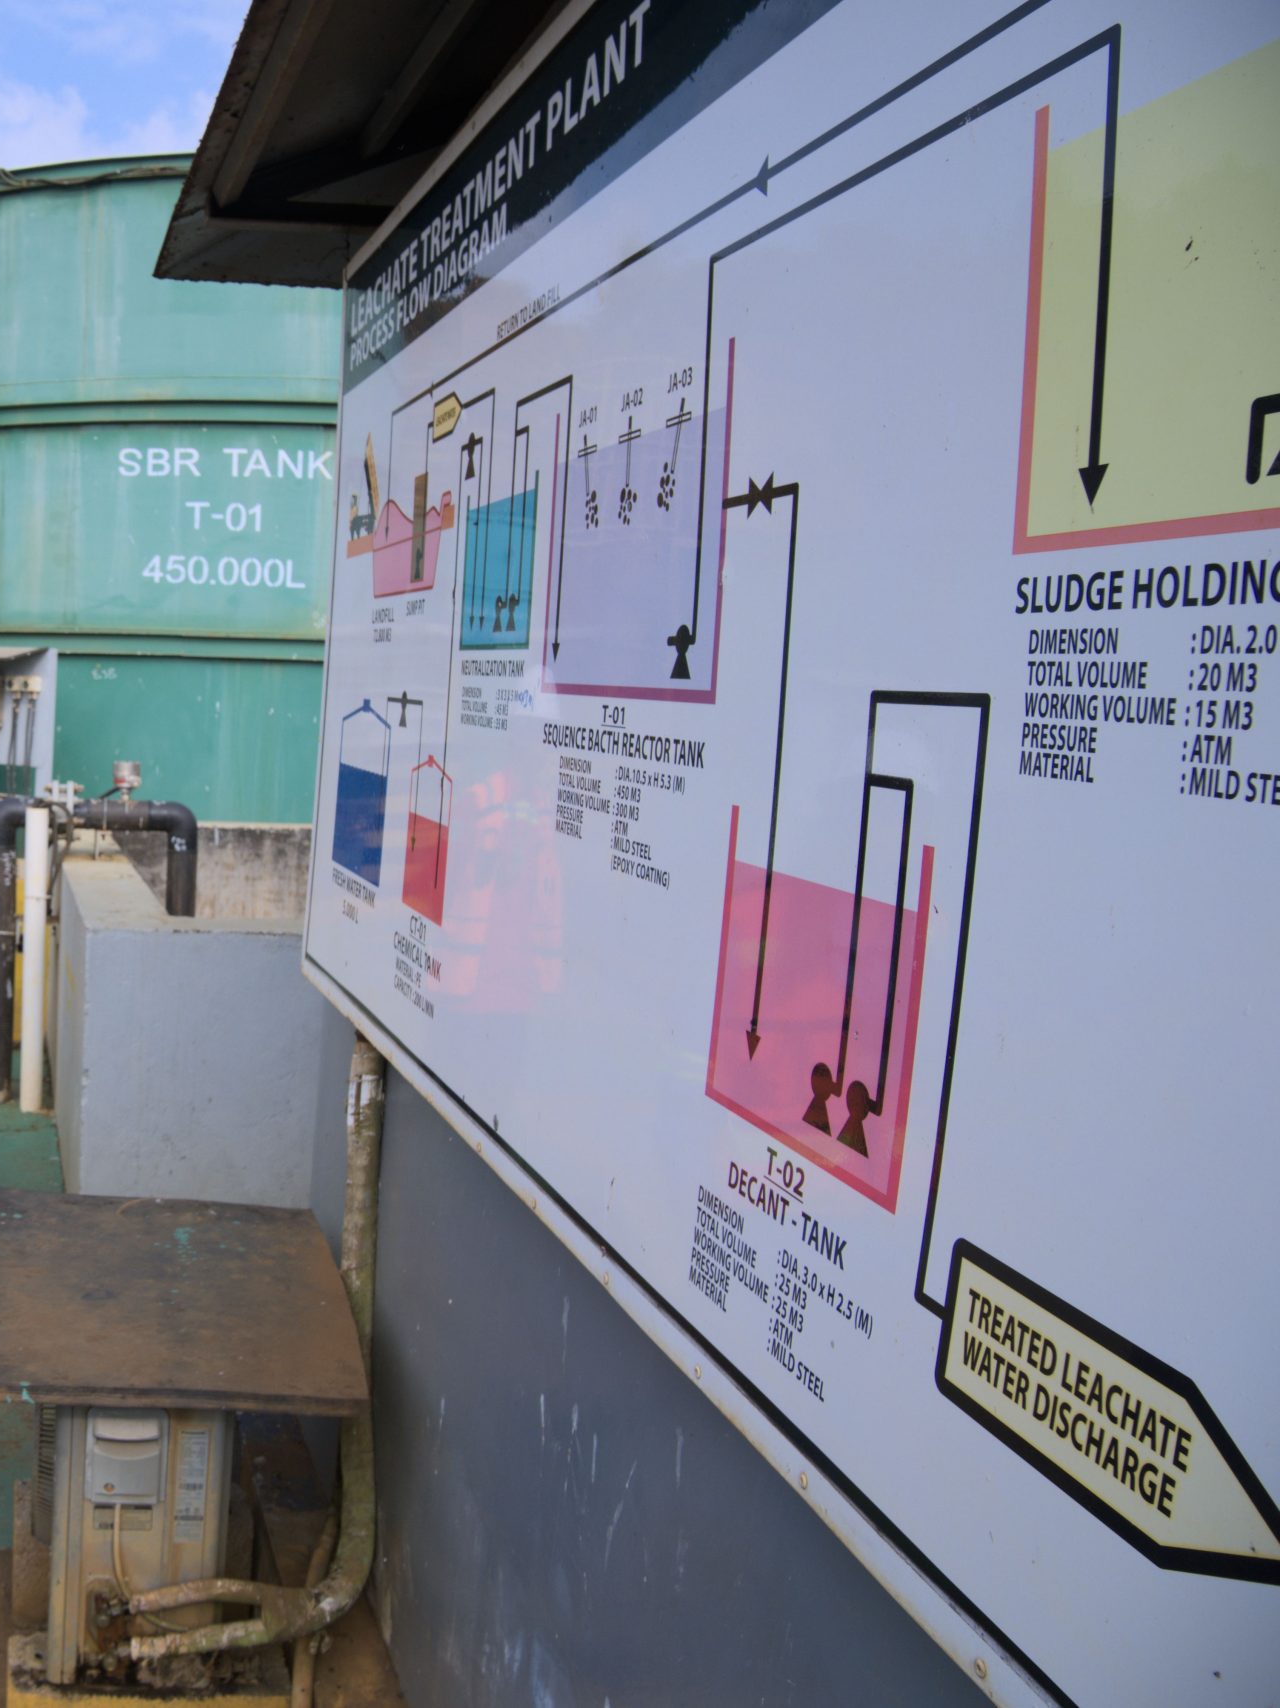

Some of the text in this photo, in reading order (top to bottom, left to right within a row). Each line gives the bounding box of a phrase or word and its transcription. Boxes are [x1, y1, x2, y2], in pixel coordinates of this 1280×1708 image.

[351, 0, 651, 337] LEACHATE TREATMENT PLANT
[350, 202, 507, 371] PROCESS FLOW DIAGRAM
[667, 366, 693, 394] JA-03
[579, 405, 598, 428] JA-01
[621, 387, 644, 412] JA-02
[118, 447, 334, 480] SBR TANK
[185, 501, 263, 532] T-01
[142, 554, 306, 589] 450.000L
[1015, 570, 1124, 614] SLUDGE
[1028, 627, 1119, 654] DIMENSION
[461, 659, 525, 678] NEUTRALIZATION TANK
[1027, 660, 1072, 688] TOTAL
[1077, 661, 1148, 689] VOLUME
[1226, 662, 1258, 692] M3
[602, 704, 626, 725] T-01
[1024, 692, 1099, 721] WORKING
[1103, 695, 1177, 726] VOLUME
[1222, 700, 1254, 730] M3
[543, 723, 706, 769] SEQUENCE BACTH REACTOR TANK
[1021, 723, 1098, 753] PRESSURE
[559, 755, 592, 774] DIMENSION
[653, 772, 659, 788] H
[672, 775, 686, 795] (M)
[1019, 750, 1095, 783] MATERIAL
[557, 788, 584, 807] WORKING
[584, 796, 610, 814] VOLUME
[628, 805, 640, 822] M3
[559, 772, 575, 789] TOTAL
[576, 776, 601, 794] VOLUME
[630, 787, 641, 804] M3
[556, 804, 583, 824] PRESSURE
[555, 819, 582, 840] MATERIAL
[631, 841, 652, 861] STEEL
[346, 877, 362, 898] WATER
[362, 884, 376, 909] TANK
[635, 862, 670, 890] COATING)
[410, 915, 427, 942] CT-01
[393, 931, 442, 982] CHEMICAL TANK
[766, 1146, 805, 1198] T-02
[728, 1161, 790, 1227] DECANT
[801, 1211, 847, 1271] TANK
[691, 1246, 730, 1293] PRESSURE
[696, 1205, 720, 1239] TOTAL
[721, 1230, 757, 1269] VOLUME
[792, 1281, 808, 1310] M3
[697, 1185, 744, 1235] DIMENSION
[826, 1279, 836, 1304] H
[837, 1292, 853, 1320] 2.5
[854, 1305, 874, 1340] (M)
[693, 1226, 731, 1271] WORKING
[732, 1261, 770, 1304] VOLUME
[788, 1304, 804, 1333] M3
[689, 1267, 727, 1313] MATERIAL
[796, 1362, 825, 1402] STEEL
[968, 1287, 1192, 1474] TREATED LEACHATE
[962, 1330, 1176, 1519] WATER DISCHARGE
